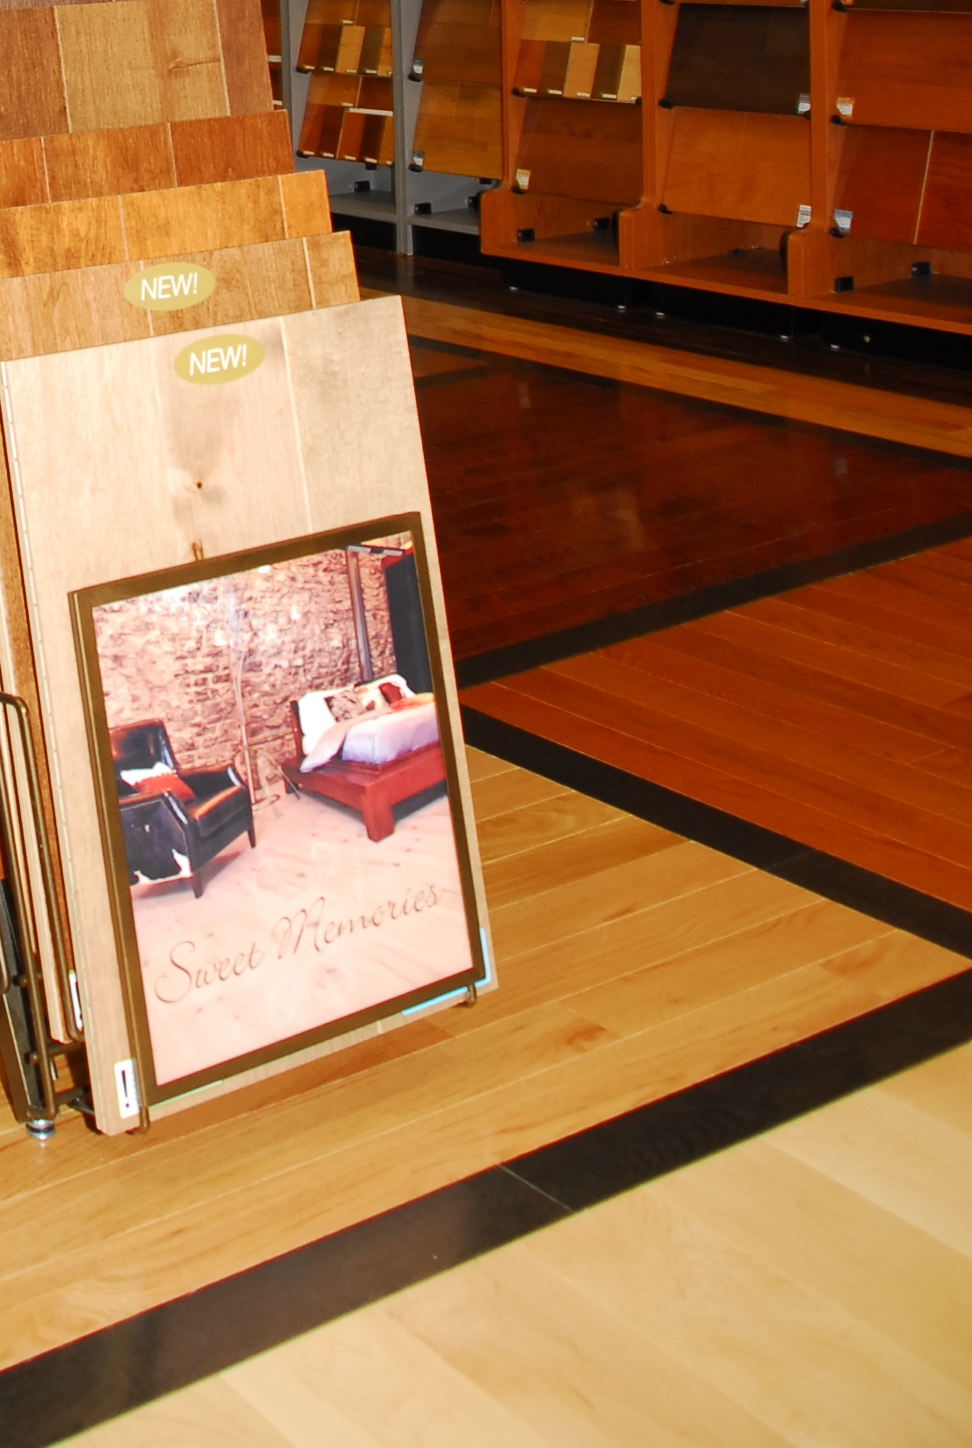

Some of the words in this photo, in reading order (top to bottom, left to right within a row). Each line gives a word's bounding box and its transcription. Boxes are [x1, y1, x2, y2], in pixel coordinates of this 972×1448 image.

[140, 272, 198, 302] NEW!
[189, 343, 248, 377] NEW!
[153, 939, 266, 1004] Sweet
[271, 884, 448, 960] Memories
